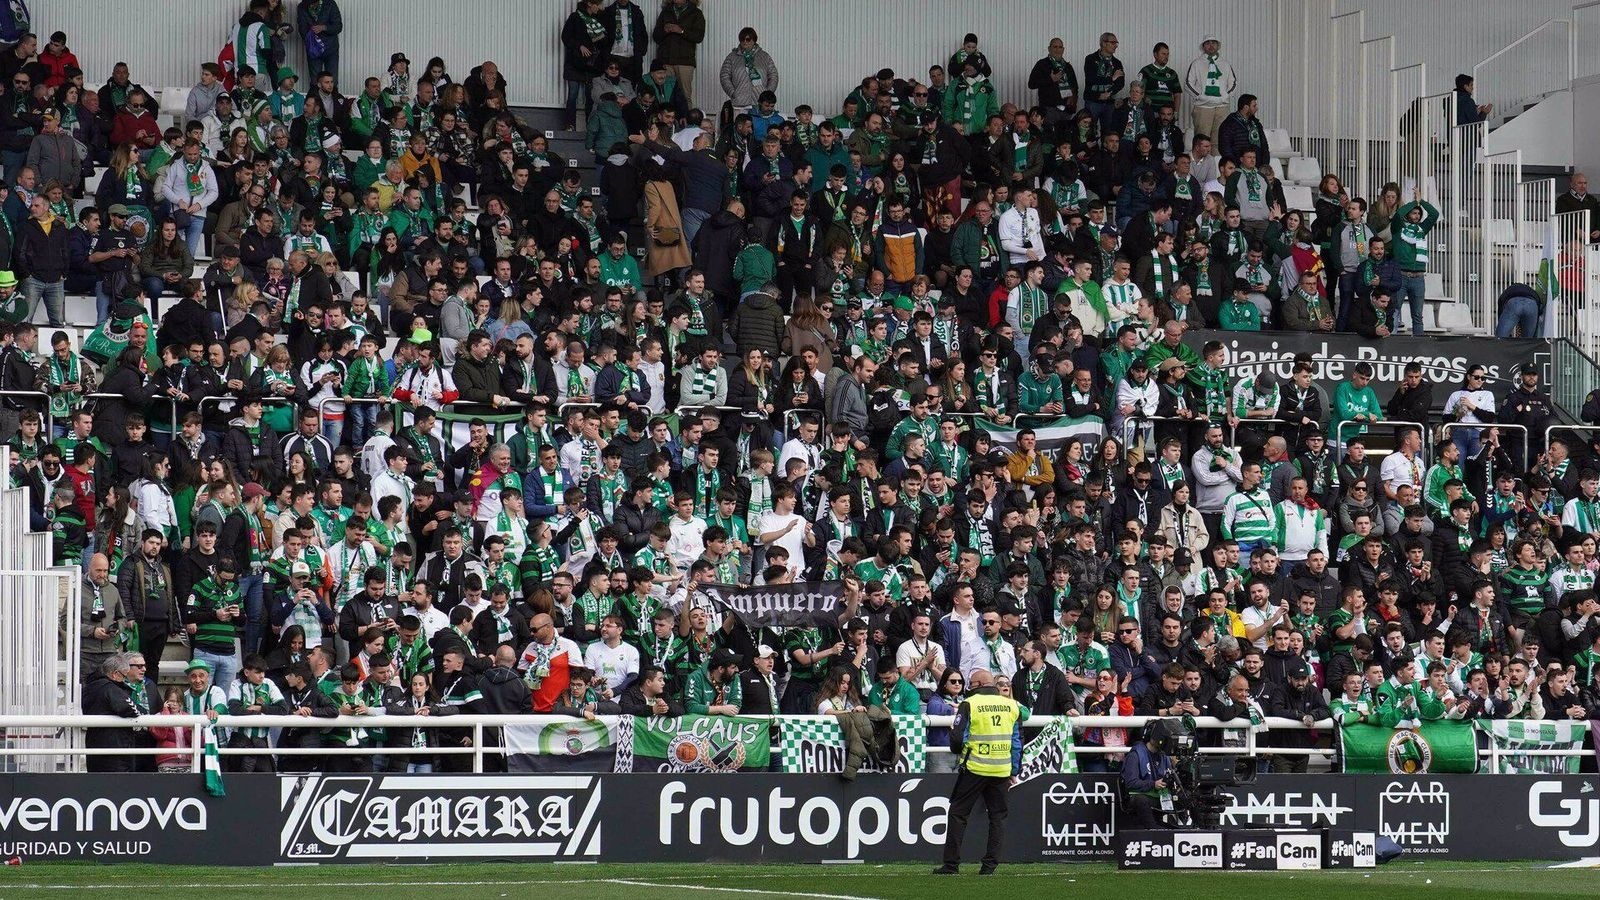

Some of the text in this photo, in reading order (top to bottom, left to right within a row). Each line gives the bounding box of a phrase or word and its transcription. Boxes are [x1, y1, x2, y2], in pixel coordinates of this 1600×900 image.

[1309, 342, 1346, 381] de
[646, 714, 760, 744] VOLCAUS
[991, 715, 1002, 727] 12
[1049, 782, 1109, 805] CAR
[1386, 781, 1444, 803] CAR
[1047, 824, 1110, 846] MEN
[1384, 823, 1445, 844] MEN
[77, 842, 88, 854] Y
[93, 842, 151, 854] SALUD
